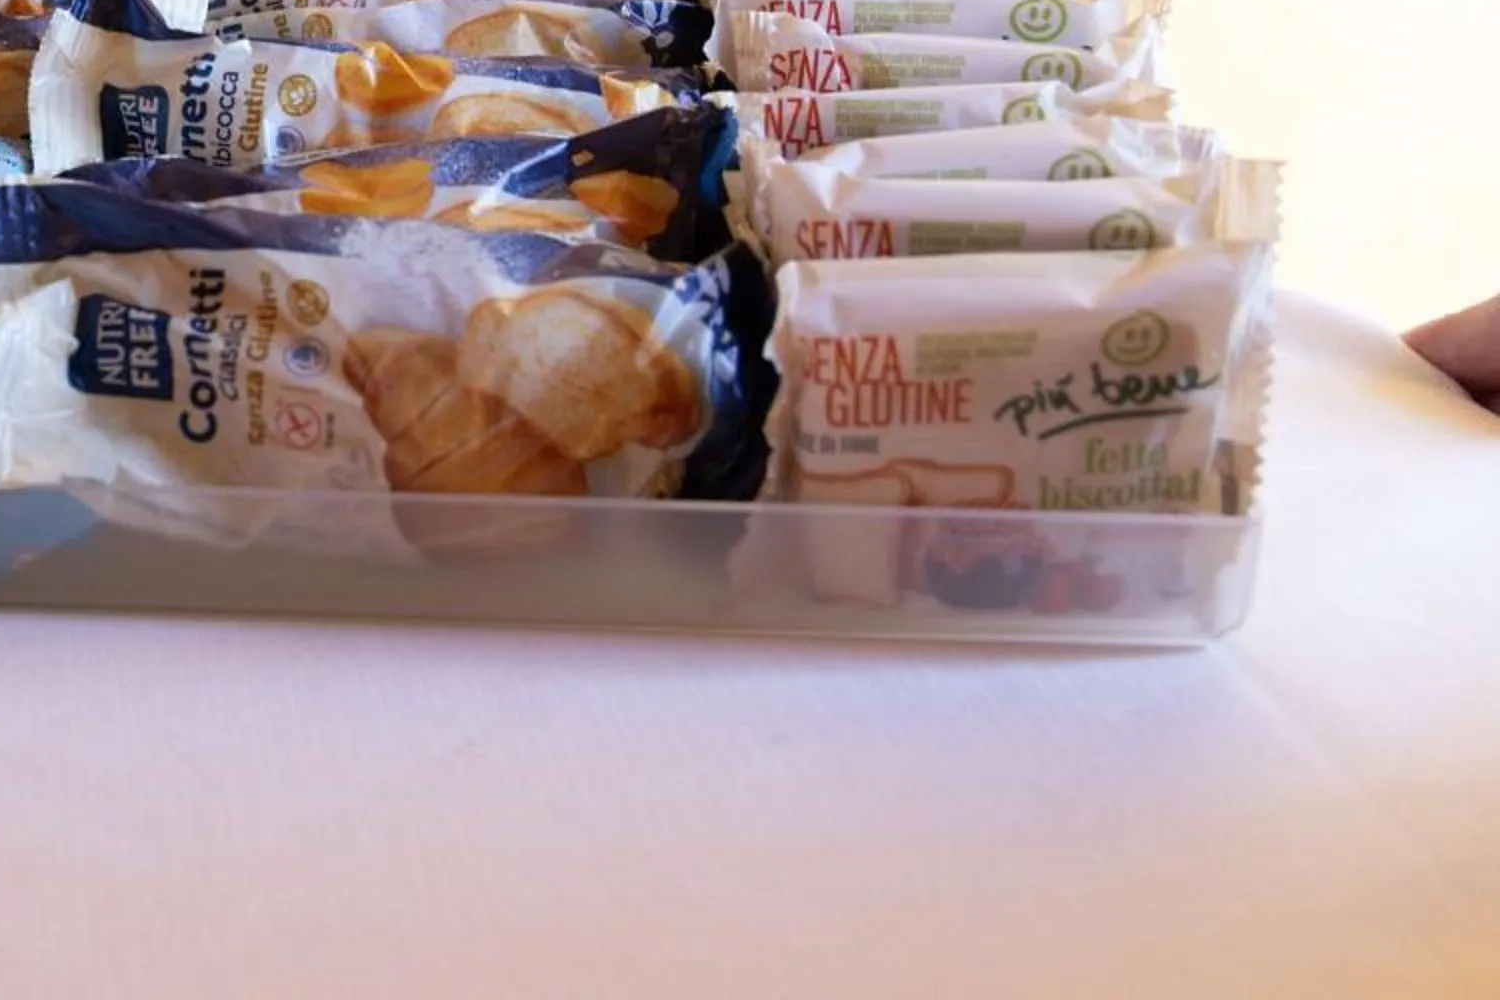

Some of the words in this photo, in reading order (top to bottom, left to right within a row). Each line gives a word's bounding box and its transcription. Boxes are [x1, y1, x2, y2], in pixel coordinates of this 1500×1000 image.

[238, 63, 269, 153] Glutine
[796, 219, 897, 260] SENZA
[97, 301, 127, 387] NUTRI
[178, 269, 226, 444] Cornetti
[825, 378, 974, 428] GLUTINE
[1089, 361, 1222, 405] bene
